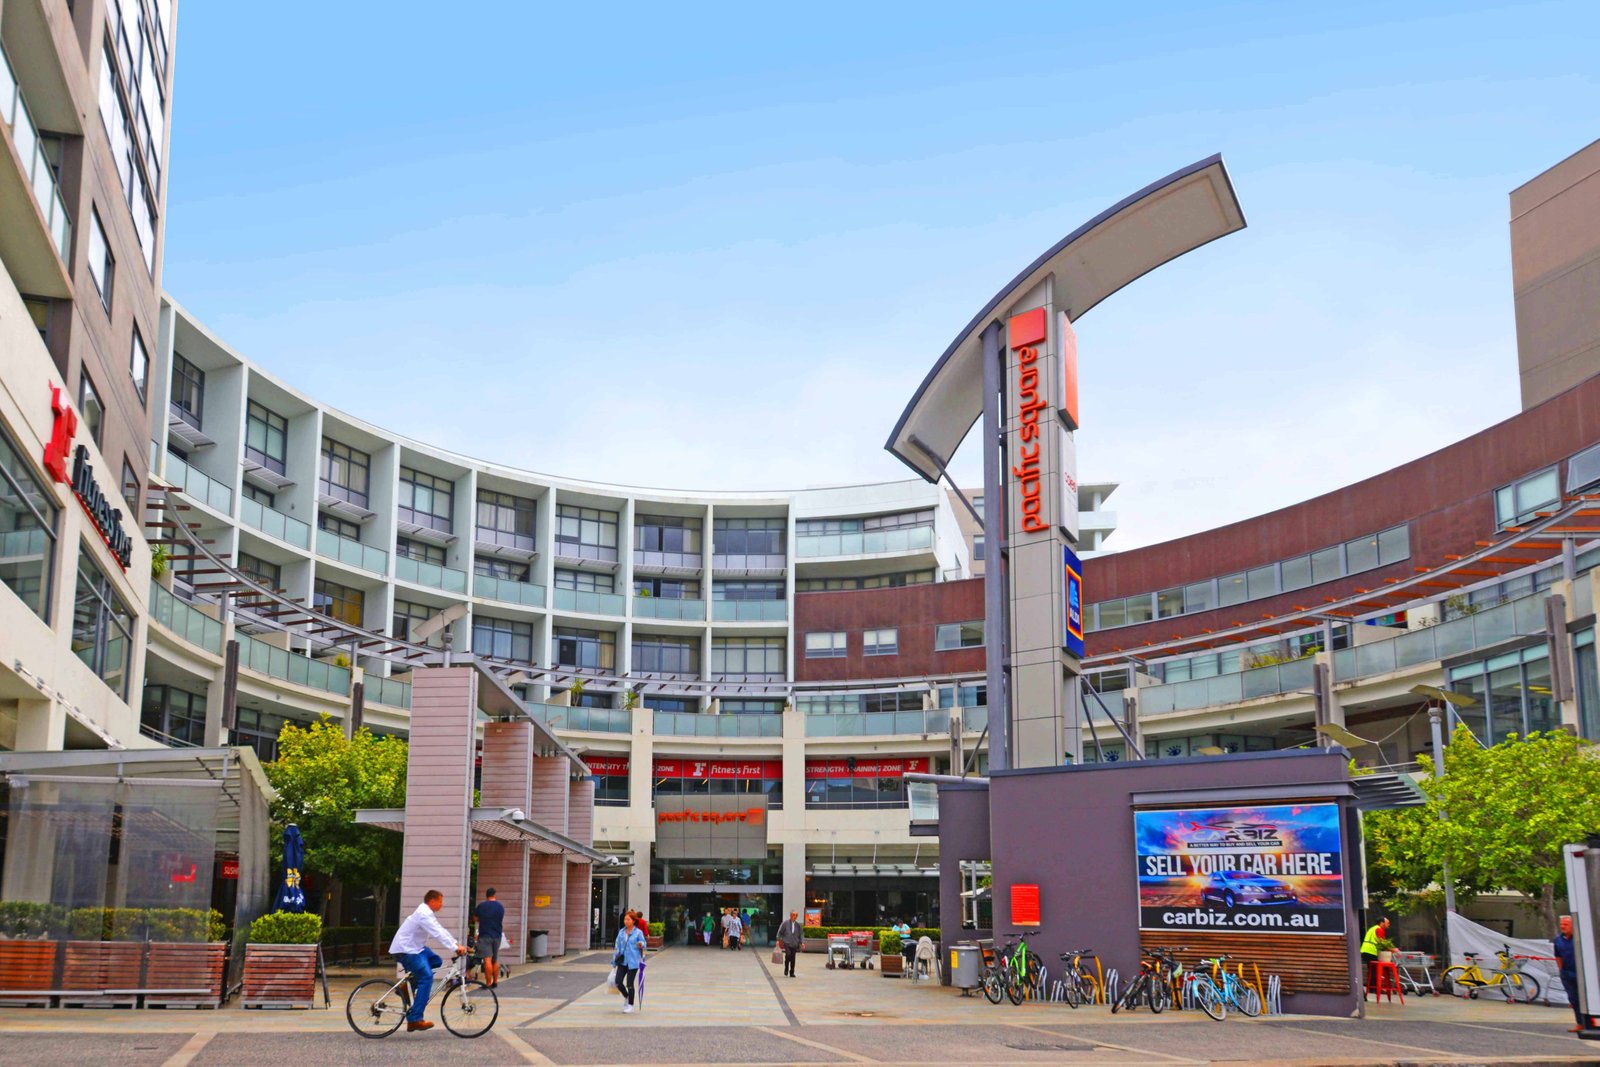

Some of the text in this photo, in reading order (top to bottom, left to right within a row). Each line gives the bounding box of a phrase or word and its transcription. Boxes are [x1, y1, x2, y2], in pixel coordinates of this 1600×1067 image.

[1012, 346, 1049, 533] pacific square
[711, 765, 741, 775] fitness
[742, 765, 761, 774] first
[882, 764, 902, 772] ZONE
[658, 808, 747, 826] pacific square
[1192, 829, 1279, 841] CARBIZ
[1146, 852, 1333, 876] SELL YOUR CAR HERE
[1163, 909, 1320, 927] carbiz.com.au
